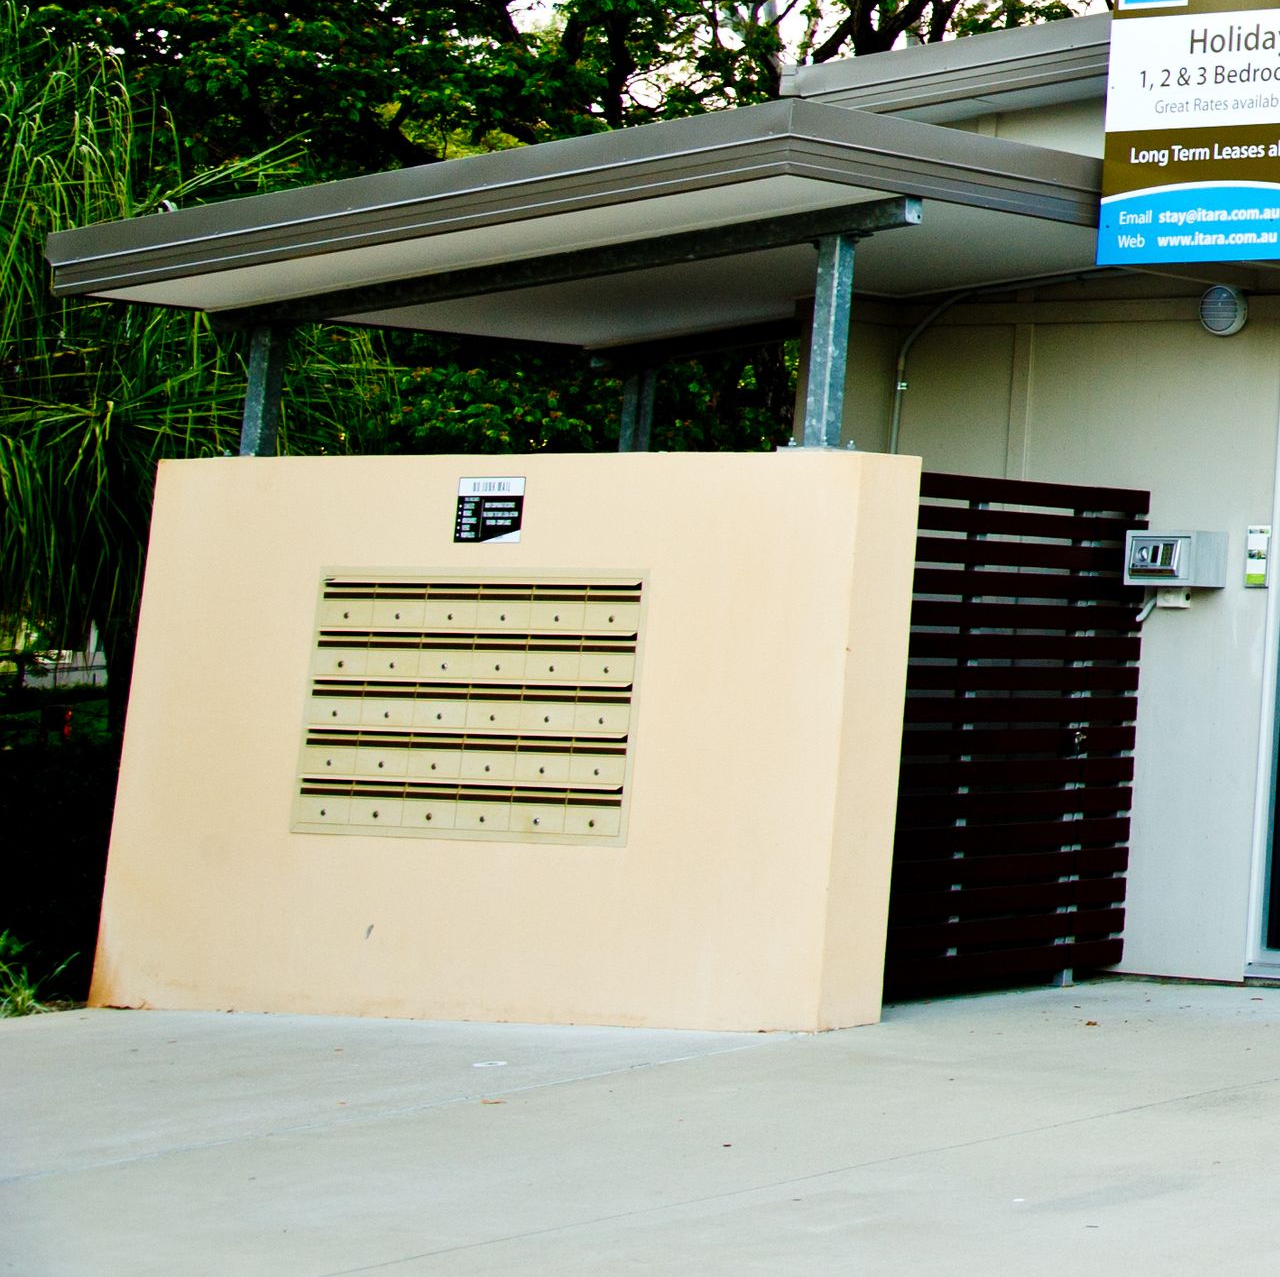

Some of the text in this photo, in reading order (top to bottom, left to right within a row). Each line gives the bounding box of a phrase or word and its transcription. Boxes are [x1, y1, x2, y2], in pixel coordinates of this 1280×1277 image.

[1139, 70, 1154, 91] 1,
[1160, 69, 1171, 87] 2
[1177, 67, 1191, 86] &
[1196, 67, 1207, 85] 3
[1154, 99, 1190, 114] Great
[1194, 97, 1229, 112] Rates
[1130, 147, 1170, 167] Long
[1171, 145, 1210, 162] Term
[1213, 143, 1265, 160] Leases
[1119, 207, 1280, 226] Email stay@itara.com.au
[1117, 231, 1278, 248] Web www.itara.com.au
